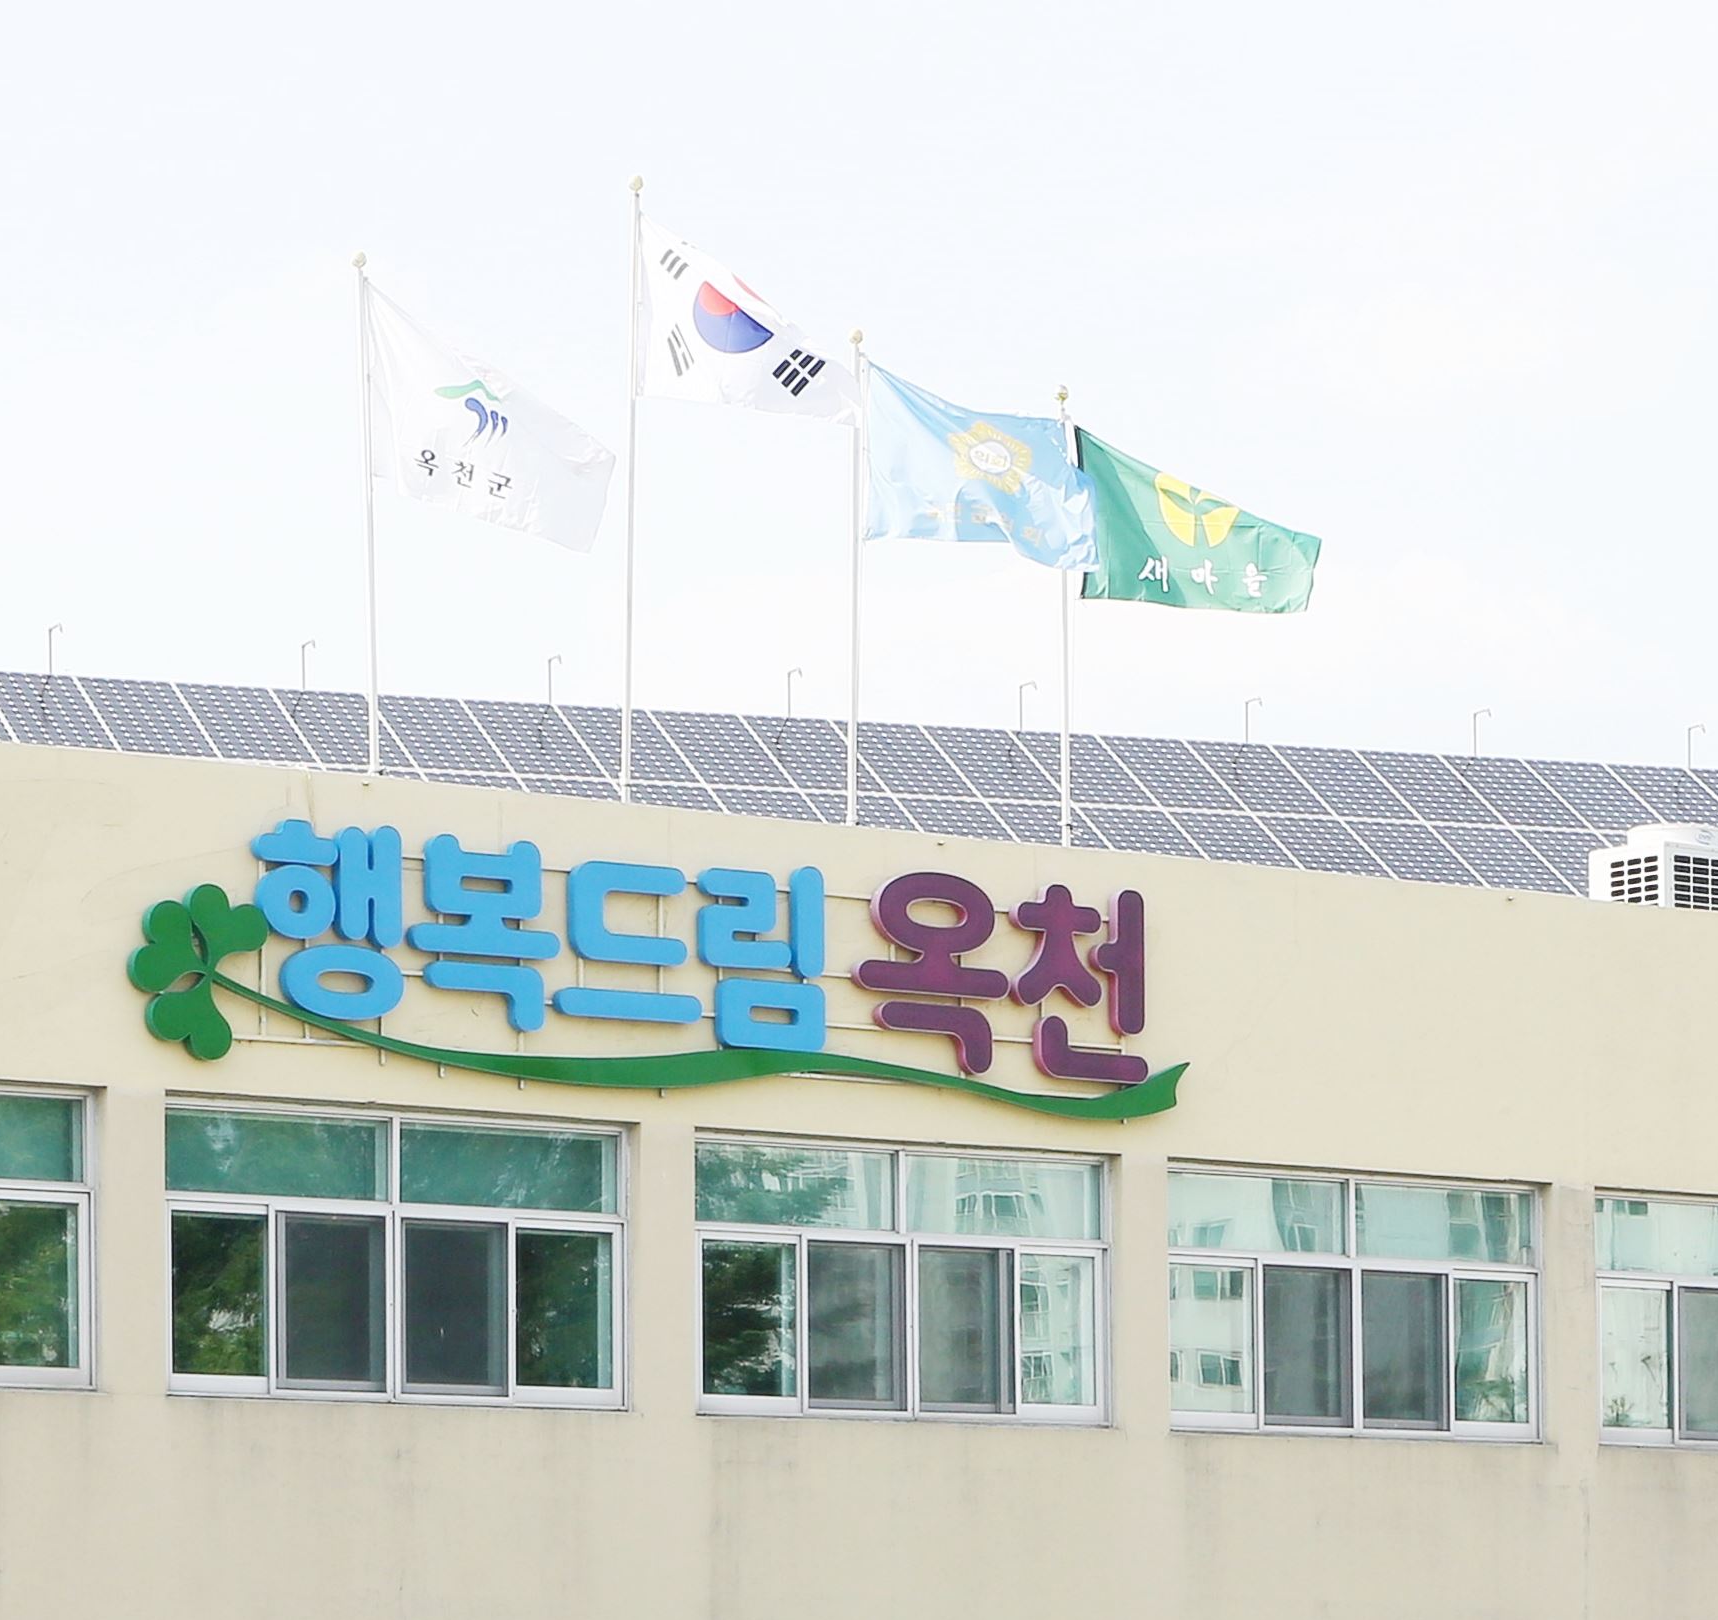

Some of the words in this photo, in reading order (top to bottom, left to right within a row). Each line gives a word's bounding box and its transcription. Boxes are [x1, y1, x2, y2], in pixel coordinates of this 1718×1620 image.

[413, 449, 513, 499] 옥천군
[1138, 554, 1269, 599] 새마을
[250, 818, 826, 1052] 행복드림
[850, 870, 1150, 1084] 옥천
